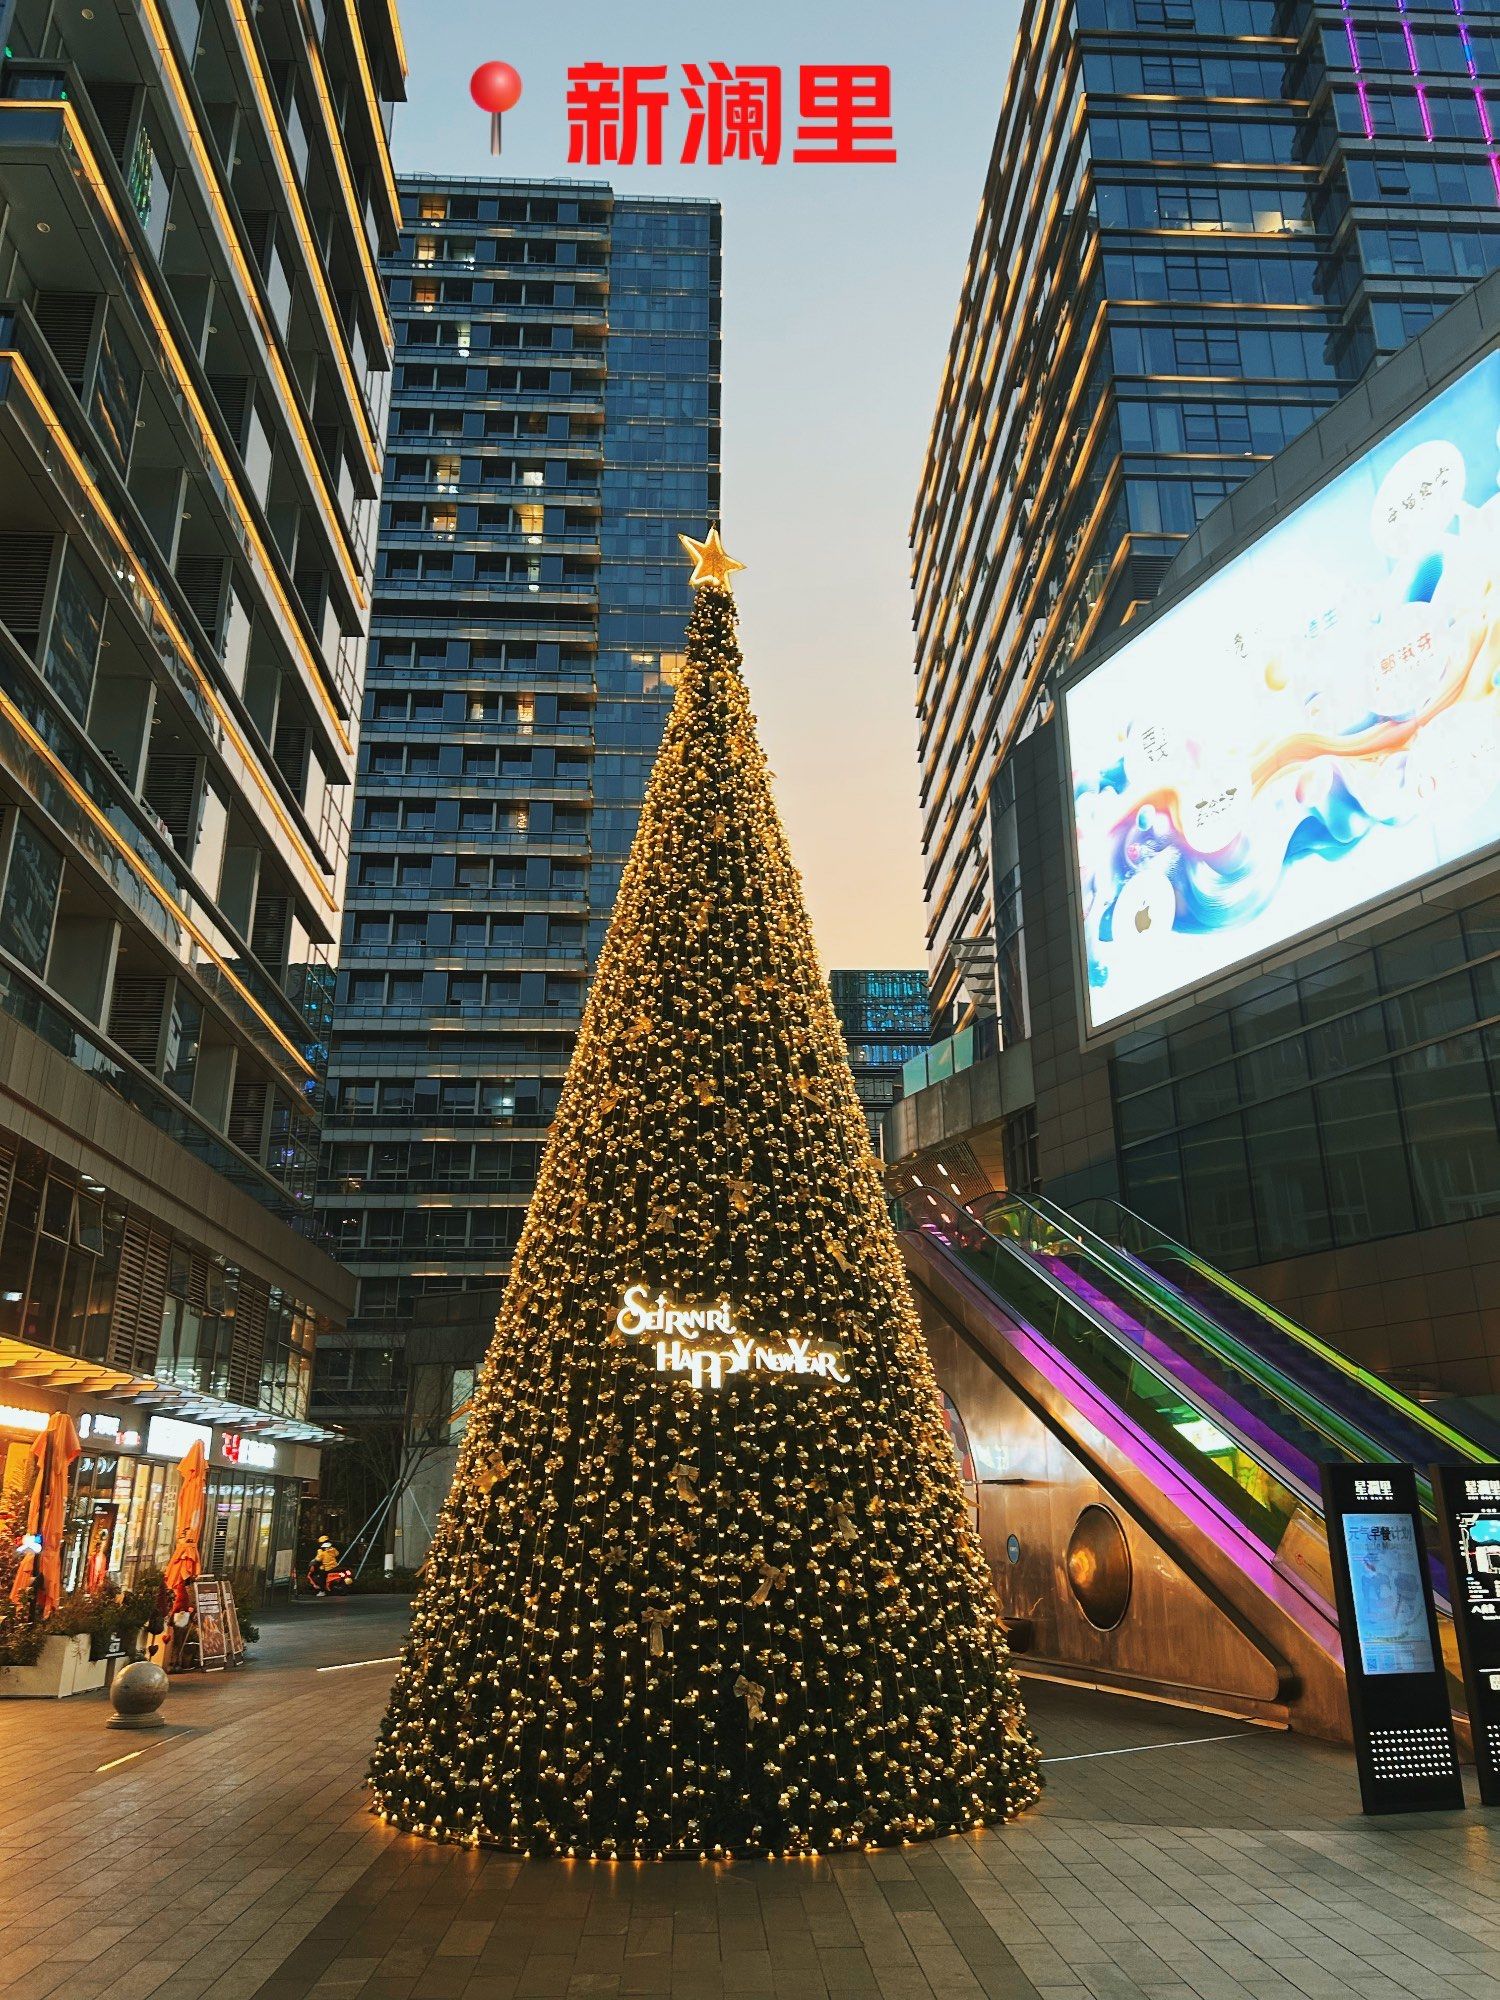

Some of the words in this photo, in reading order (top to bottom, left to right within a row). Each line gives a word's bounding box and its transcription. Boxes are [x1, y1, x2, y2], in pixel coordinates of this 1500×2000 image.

[1349, 1526, 1412, 1541] 元气早餐计划
